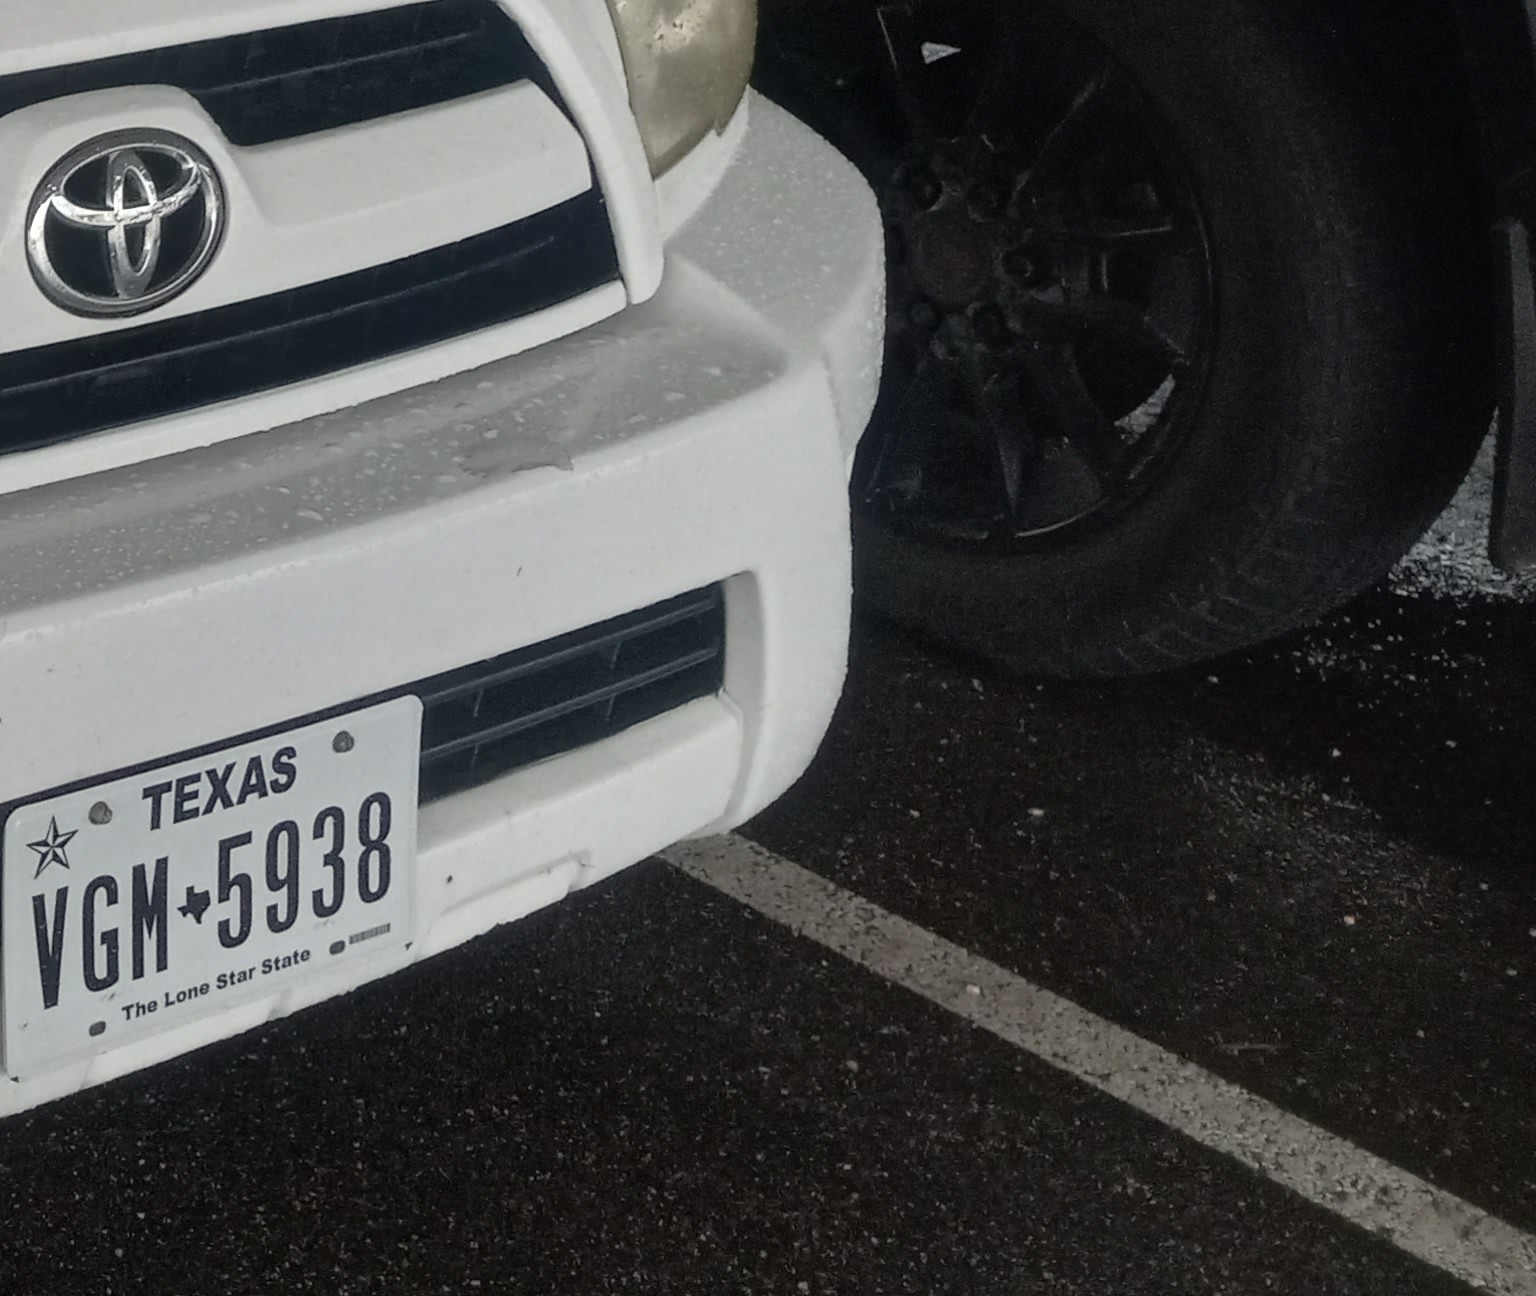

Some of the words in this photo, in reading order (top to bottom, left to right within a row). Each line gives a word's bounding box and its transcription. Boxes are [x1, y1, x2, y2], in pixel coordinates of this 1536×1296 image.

[141, 745, 298, 832] TEXAS
[121, 1001, 159, 1022] The
[164, 983, 211, 1008] Lone
[215, 965, 257, 990] Star
[260, 948, 312, 976] State
